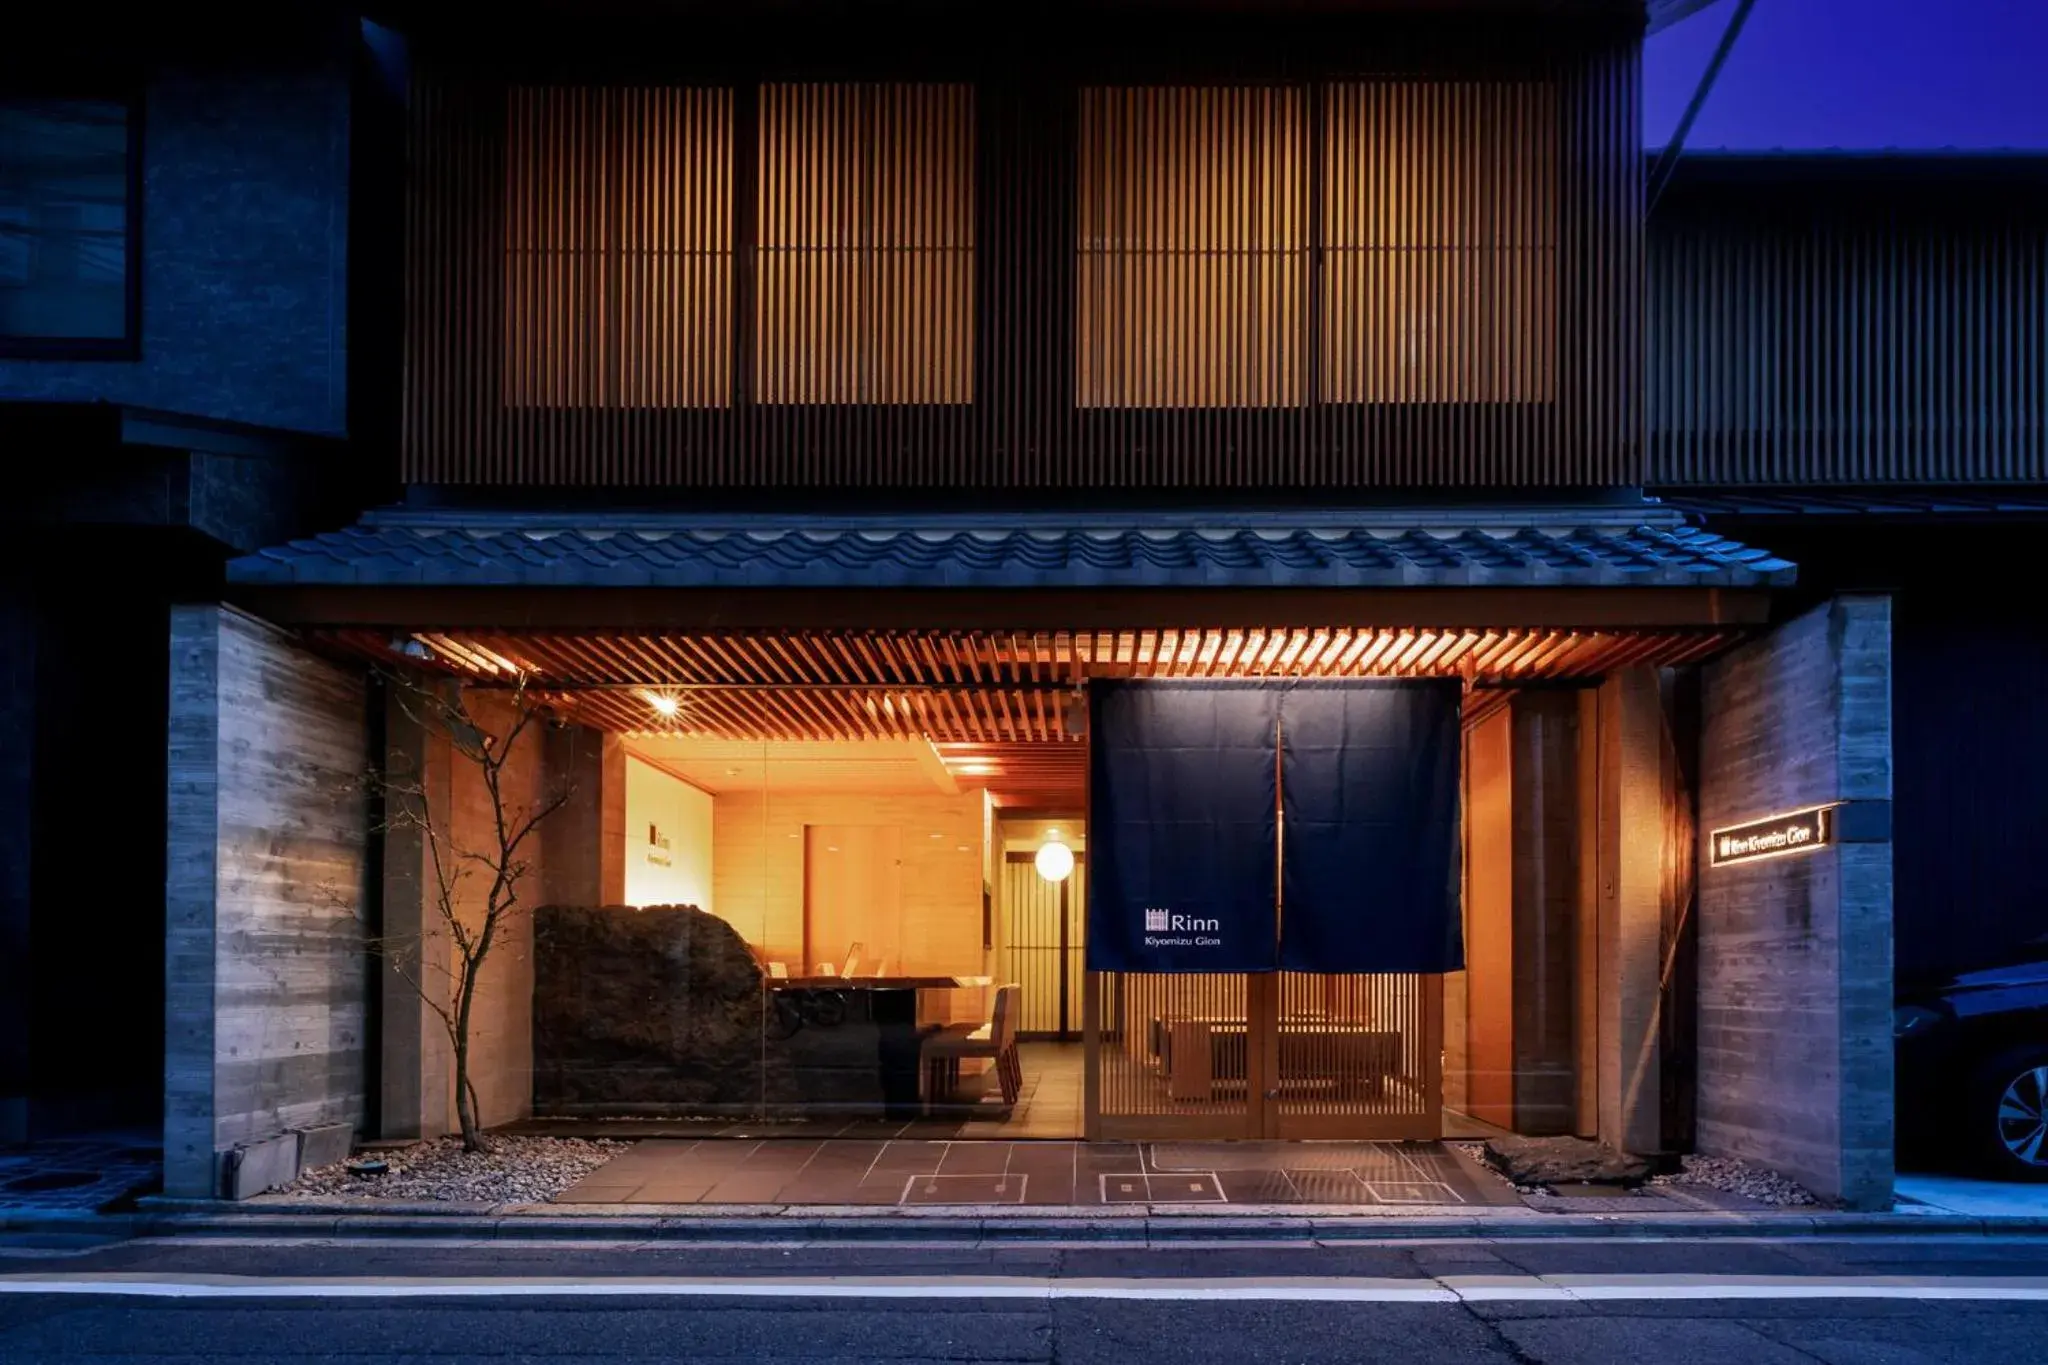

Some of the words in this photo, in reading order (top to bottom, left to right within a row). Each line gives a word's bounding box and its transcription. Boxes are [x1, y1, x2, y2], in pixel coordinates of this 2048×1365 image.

[1787, 826, 1811, 845] Gion
[1172, 914, 1219, 931] Rinn
[1145, 936, 1193, 948] Kiyomizu
[1195, 936, 1220, 946] Gion
